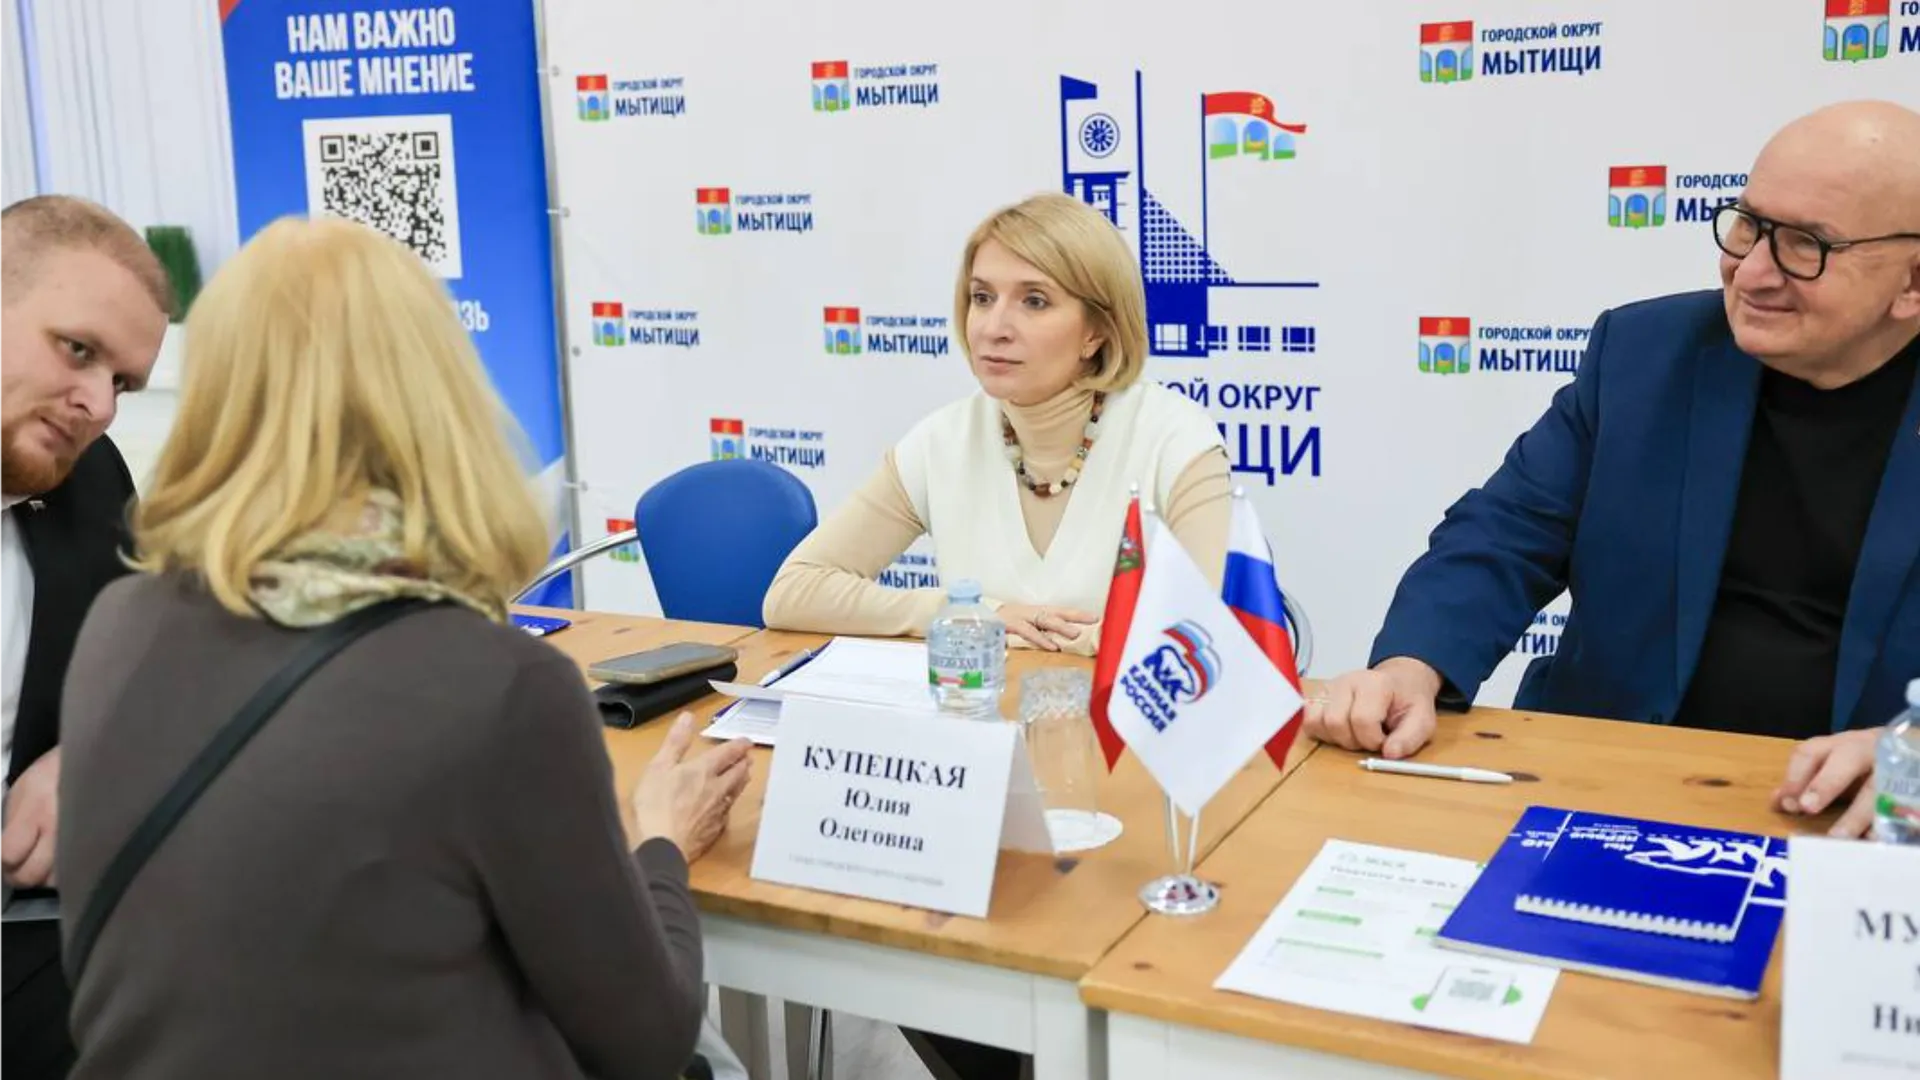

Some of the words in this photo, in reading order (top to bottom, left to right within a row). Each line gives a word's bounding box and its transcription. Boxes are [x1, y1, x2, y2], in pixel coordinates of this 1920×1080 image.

[287, 13, 348, 54] НАМ
[353, 6, 456, 50] ВАЖНО
[1482, 22, 1558, 43] ГОРОДСКОЙ
[1561, 22, 1602, 38] ОКРУГ
[1482, 45, 1601, 76] МЫТИЩИ
[274, 57, 354, 99] ВАШЕ
[358, 53, 475, 95] МНЕНИЕ
[615, 96, 685, 119] МЫТИЩИ
[857, 83, 939, 107] МЫТИЩИ
[1676, 173, 1748, 190] ГОРОДСКО
[737, 212, 813, 235] МЫТИЩИ
[630, 327, 700, 352] МЫТИЩИ
[868, 333, 949, 359] МЫТИЩИ
[1479, 325, 1553, 342] ГОРОДСКОЙ
[1479, 347, 1586, 377] МЫТИЩ
[1218, 383, 1322, 412] ОКРУГ
[750, 444, 826, 470] МЫТИЩИ
[803, 745, 967, 789] КУПЕЦКАЯ
[845, 786, 911, 817] Юлия
[819, 816, 925, 853] Олеговна
